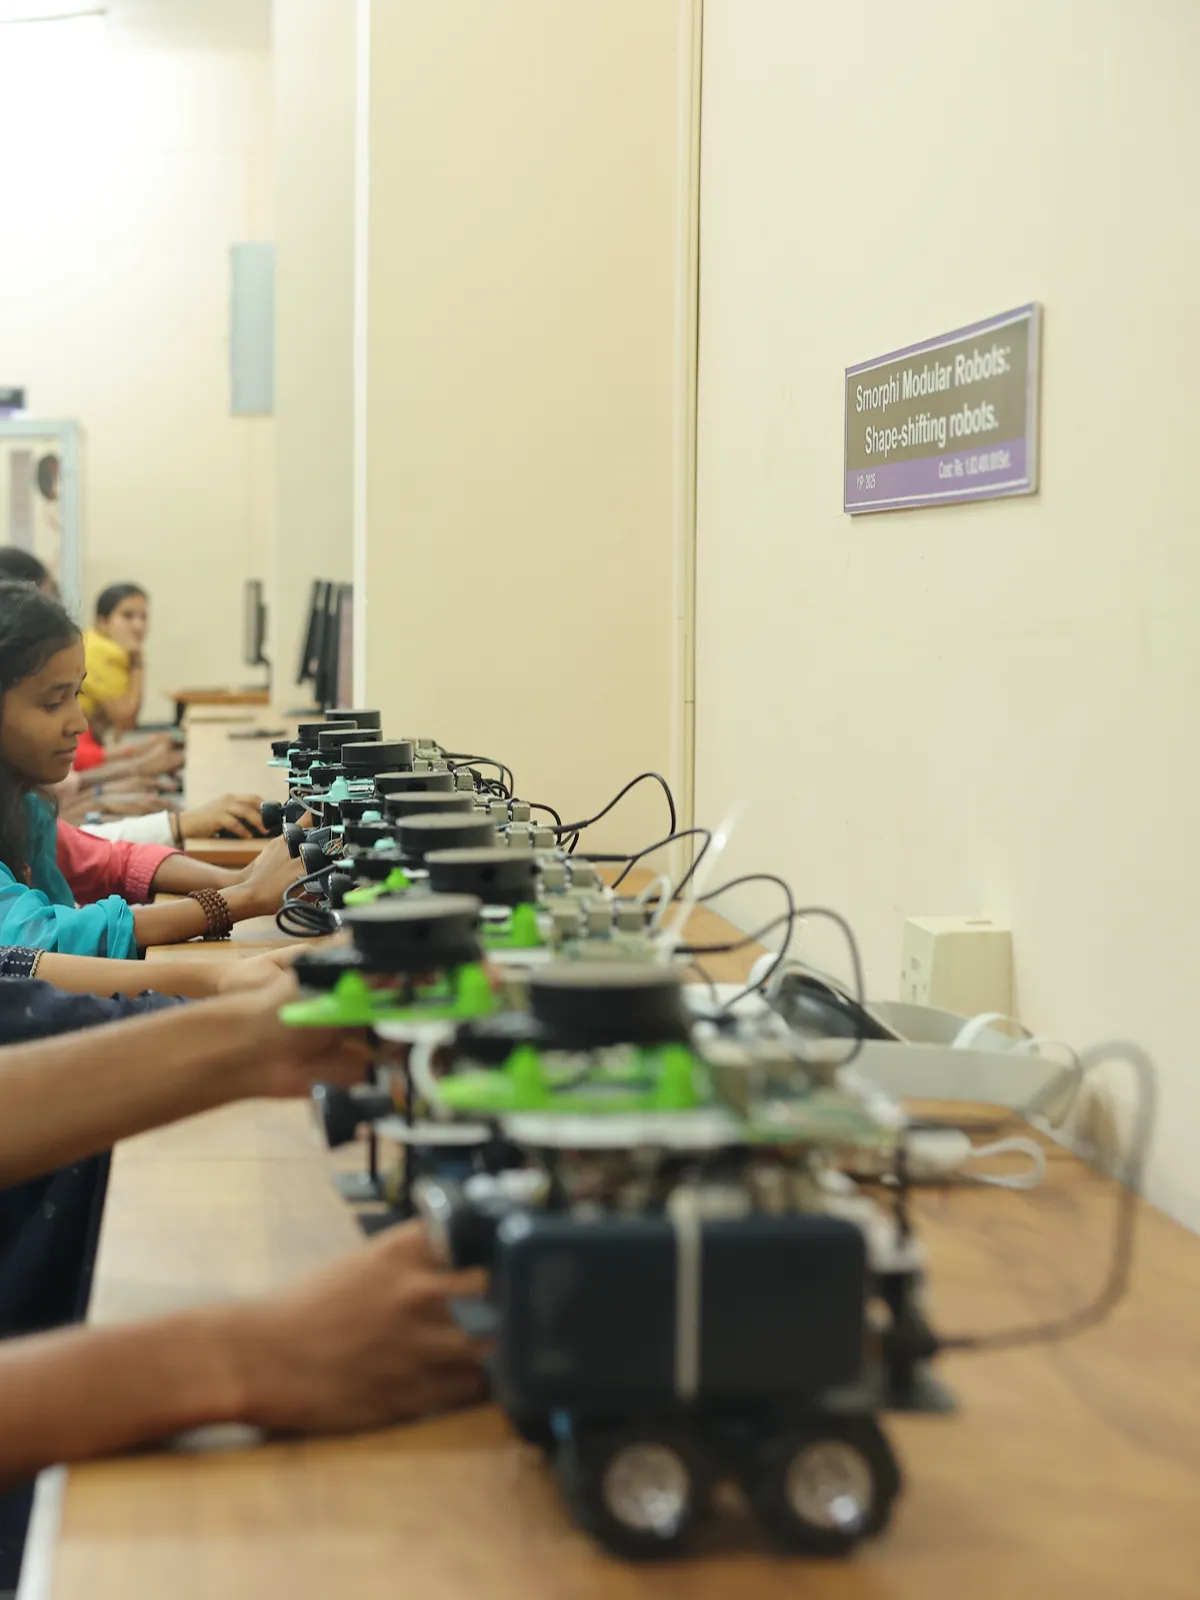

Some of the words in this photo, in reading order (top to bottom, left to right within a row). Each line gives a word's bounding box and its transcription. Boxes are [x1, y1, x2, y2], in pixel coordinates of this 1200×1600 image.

[856, 374, 900, 413] Smorphi
[902, 361, 953, 400] Modular
[865, 412, 947, 458] Shape-shifting
[949, 400, 999, 438] robots.
